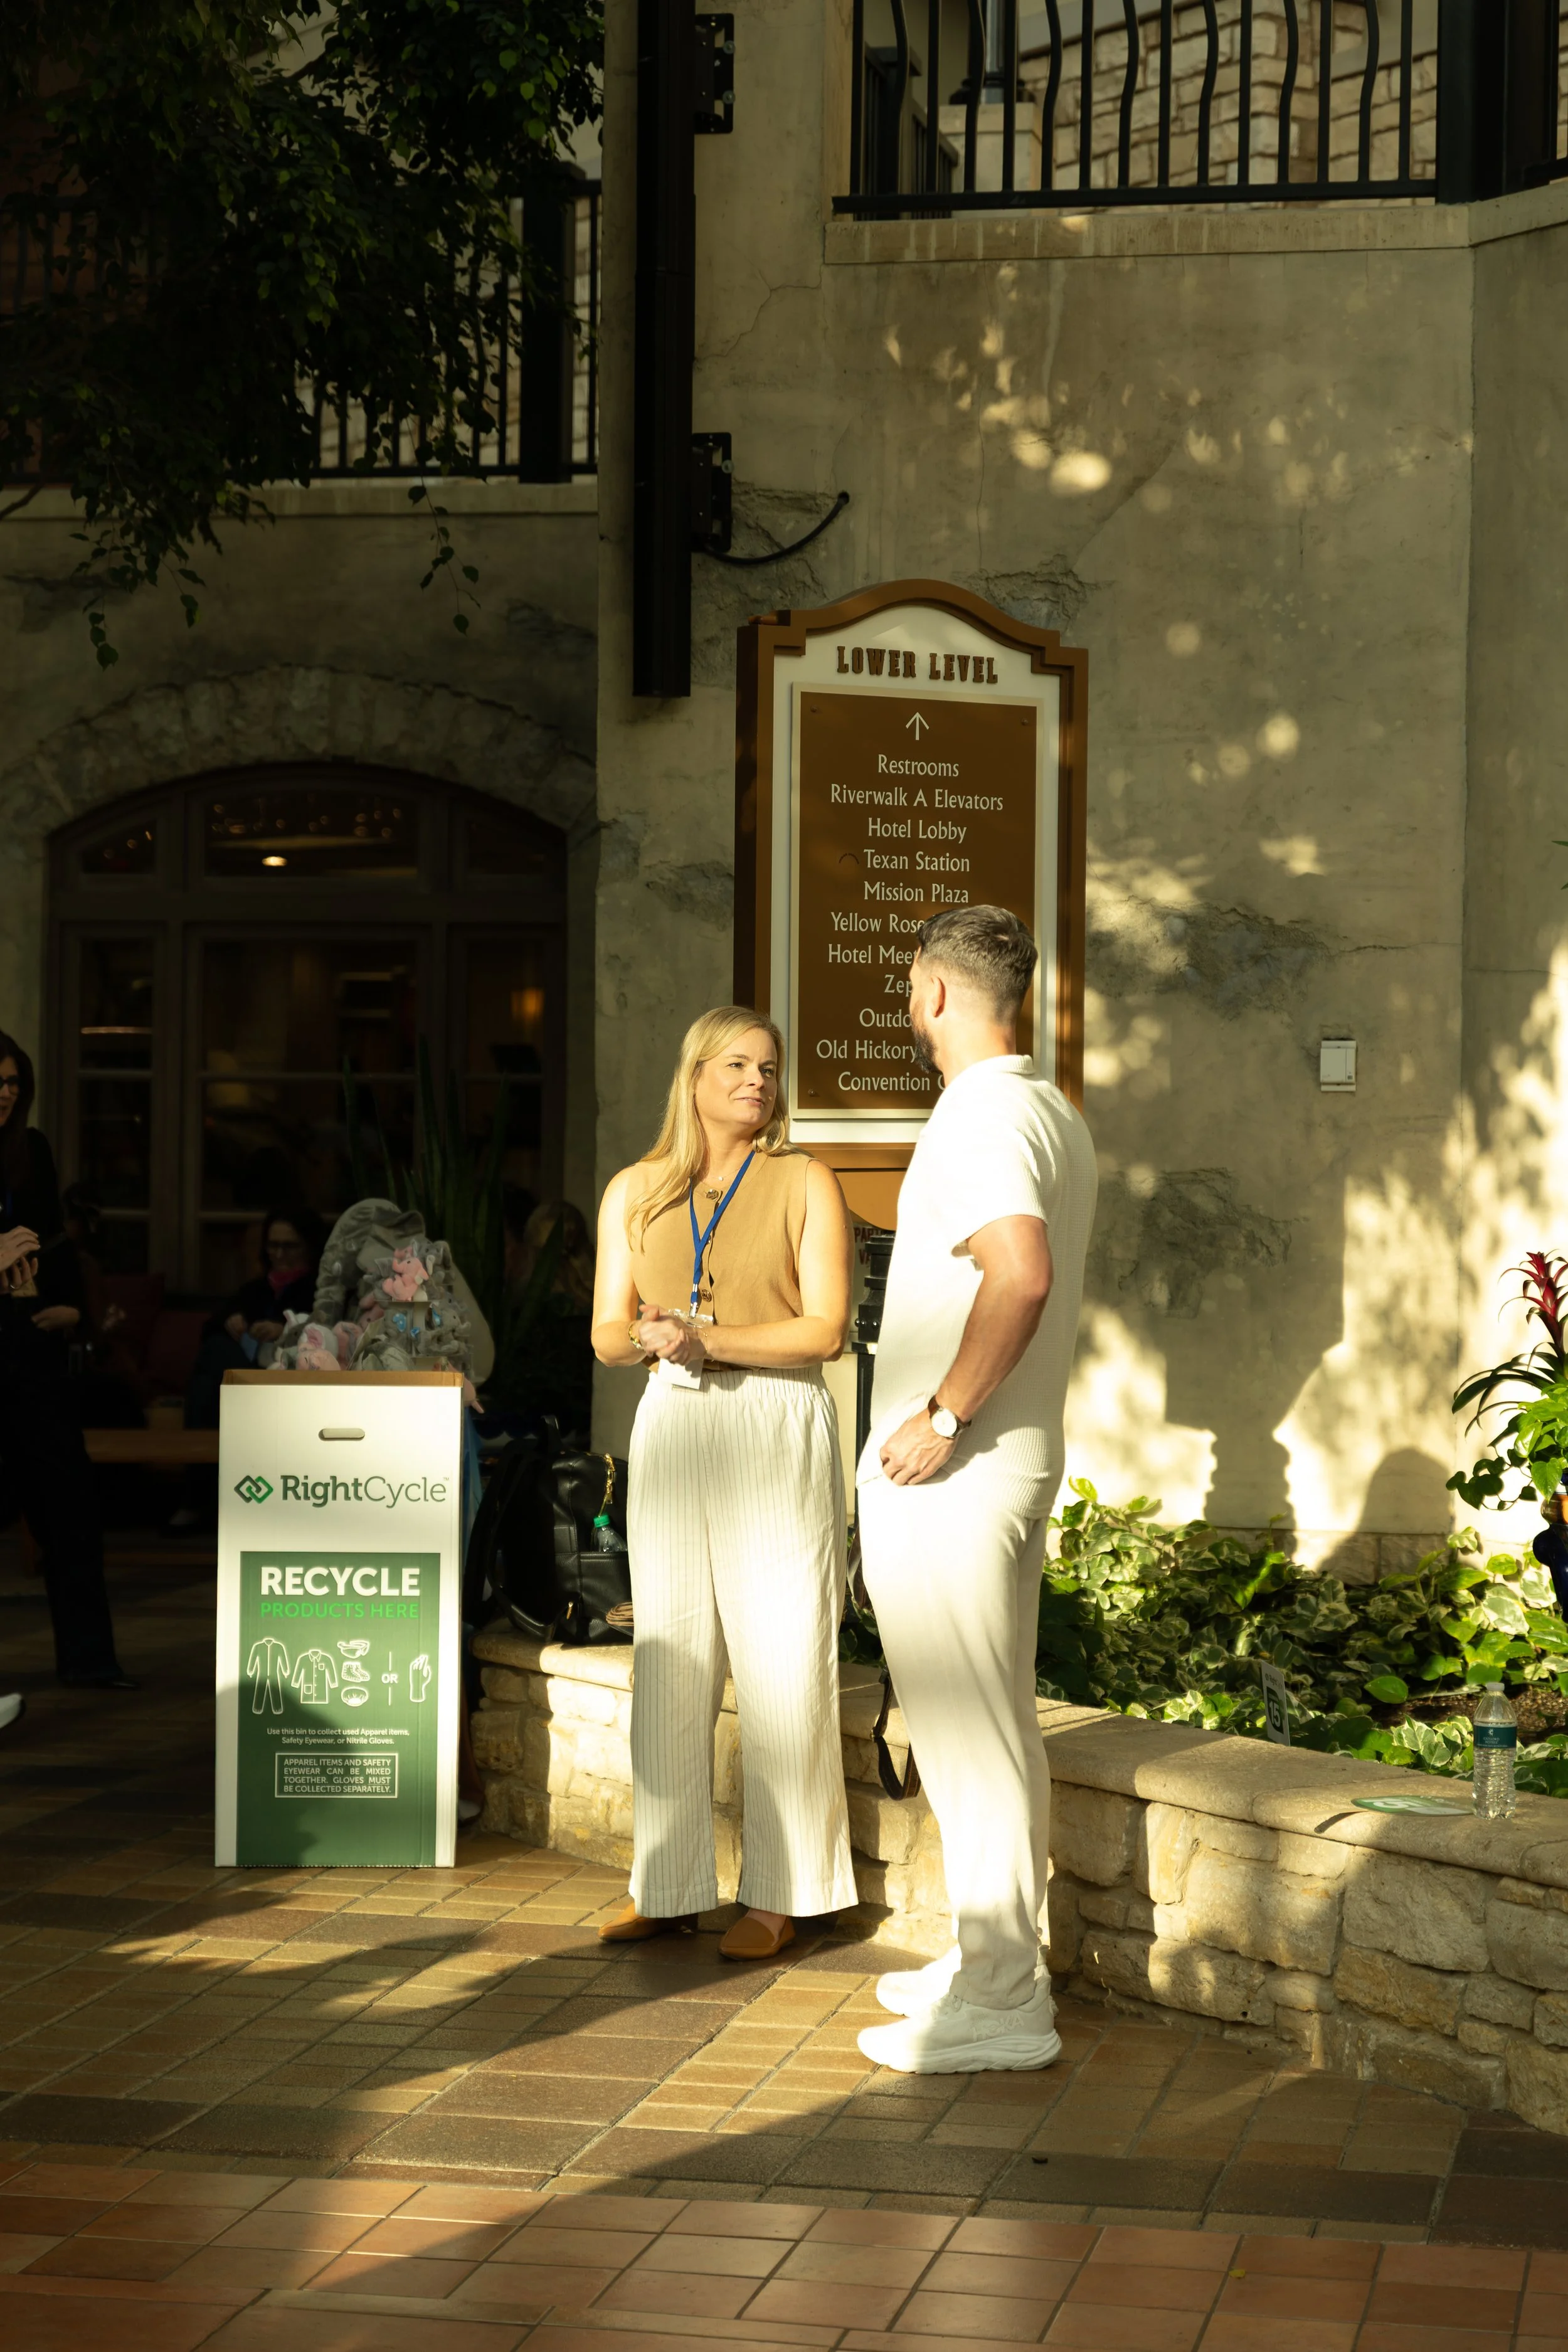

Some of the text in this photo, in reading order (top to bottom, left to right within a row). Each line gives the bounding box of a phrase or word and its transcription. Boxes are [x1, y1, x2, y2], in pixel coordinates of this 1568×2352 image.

[837, 645, 999, 684] LOWER LEVEL
[878, 755, 959, 777] Restrooms
[831, 784, 1004, 810] Riverwalk A Elevators
[868, 818, 967, 844] Hotel Lobby
[864, 849, 908, 870] Texan
[916, 851, 970, 872] Station
[864, 881, 969, 903] Mission Plaza
[831, 912, 924, 933] Yellow Rose
[829, 944, 872, 964] Hotel
[817, 1039, 916, 1063] Old Hickory
[838, 1071, 930, 1091] Convention
[261, 1566, 420, 1596] RECYCLE
[260, 1602, 419, 1619] PRODUCTS HERE
[381, 1673, 398, 1683] OR
[1269, 1701, 1281, 1727] 15
[282, 1737, 303, 1745] Safety
[972, 2011, 1025, 2042] HOKA
